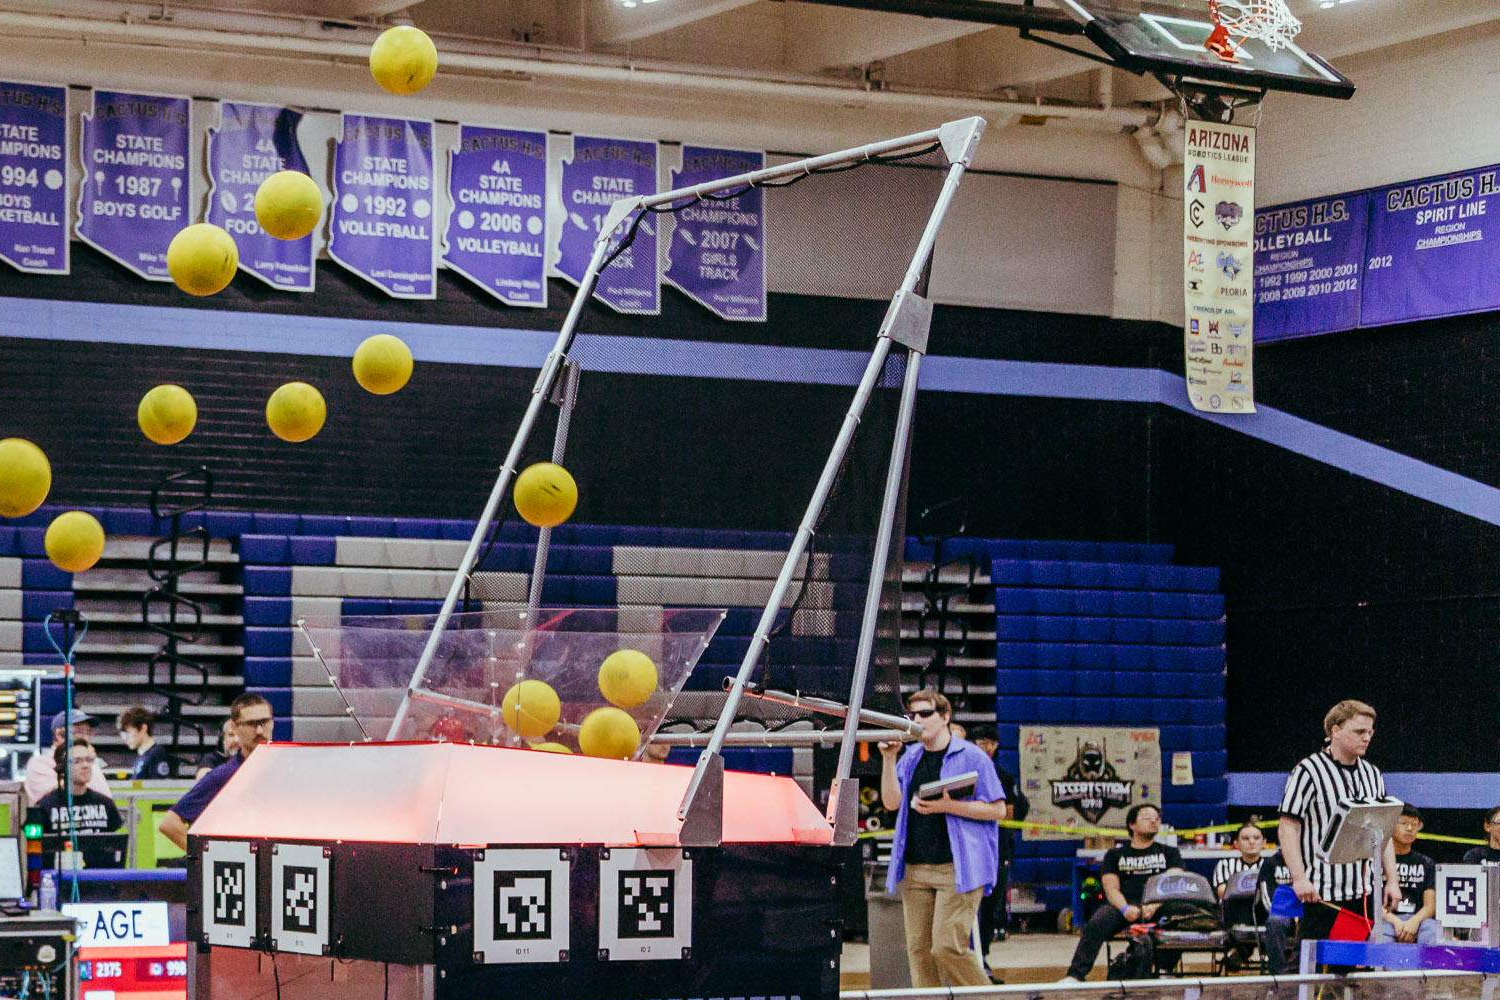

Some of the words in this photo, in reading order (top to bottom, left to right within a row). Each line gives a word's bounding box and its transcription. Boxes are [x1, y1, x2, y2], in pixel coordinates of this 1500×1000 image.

[116, 133, 163, 152] STATE
[255, 138, 275, 153] 4A
[461, 136, 518, 153] CACTUS
[1188, 128, 1250, 153] ARIZONA
[93, 149, 185, 170] CHAMPIONS
[242, 155, 286, 171] STATE
[575, 146, 629, 163] CACTUS
[1187, 149, 1222, 161] ROBOTICS
[1223, 153, 1249, 163] LEAGUE
[363, 156, 407, 173] STATE
[492, 159, 511, 175] 4A
[115, 175, 162, 198] 1987
[341, 170, 430, 191] CHAMPIONS
[479, 175, 523, 192] STATE
[592, 176, 635, 193] STATE
[1211, 175, 1252, 188] Honeywell
[459, 189, 542, 209] CHAMPIONS
[701, 197, 740, 210] STATE
[1387, 177, 1474, 212] CACTUS
[93, 200, 137, 218] BOYS
[139, 204, 182, 221] GOLF
[363, 195, 407, 218] 1992
[1416, 205, 1456, 226] SPIRIT
[1459, 200, 1487, 219] LINE
[479, 212, 522, 234] 2006
[681, 208, 758, 227] CHAMPIONS
[1254, 208, 1308, 235] CTUS
[339, 220, 429, 240] VOLLEYBALL
[1435, 222, 1466, 236] REGION
[457, 237, 543, 257] VOLLEYBALL
[701, 230, 740, 250] 2007
[1186, 234, 1215, 245] PRESENTING
[1216, 239, 1248, 248] SPONSORS
[1254, 228, 1332, 252] OLLEYBALL
[1415, 230, 1483, 249] CHAMPIONSHIPS
[701, 252, 737, 268] GIRLS
[1270, 250, 1299, 261] REGION
[1369, 255, 1393, 270] 2012
[699, 265, 740, 282] TRACK
[1260, 274, 1282, 288] 1992
[1285, 270, 1307, 285] 1999
[1309, 267, 1333, 281] 2000
[1334, 263, 1358, 278] 2001
[1220, 287, 1248, 297] PEORIA
[1259, 290, 1281, 304] 2008
[1283, 286, 1306, 300] 2009
[1308, 282, 1331, 297] 2010
[1333, 278, 1358, 293] 2012
[1053, 781, 1094, 797] DESERT
[96, 961, 122, 978] 2375
